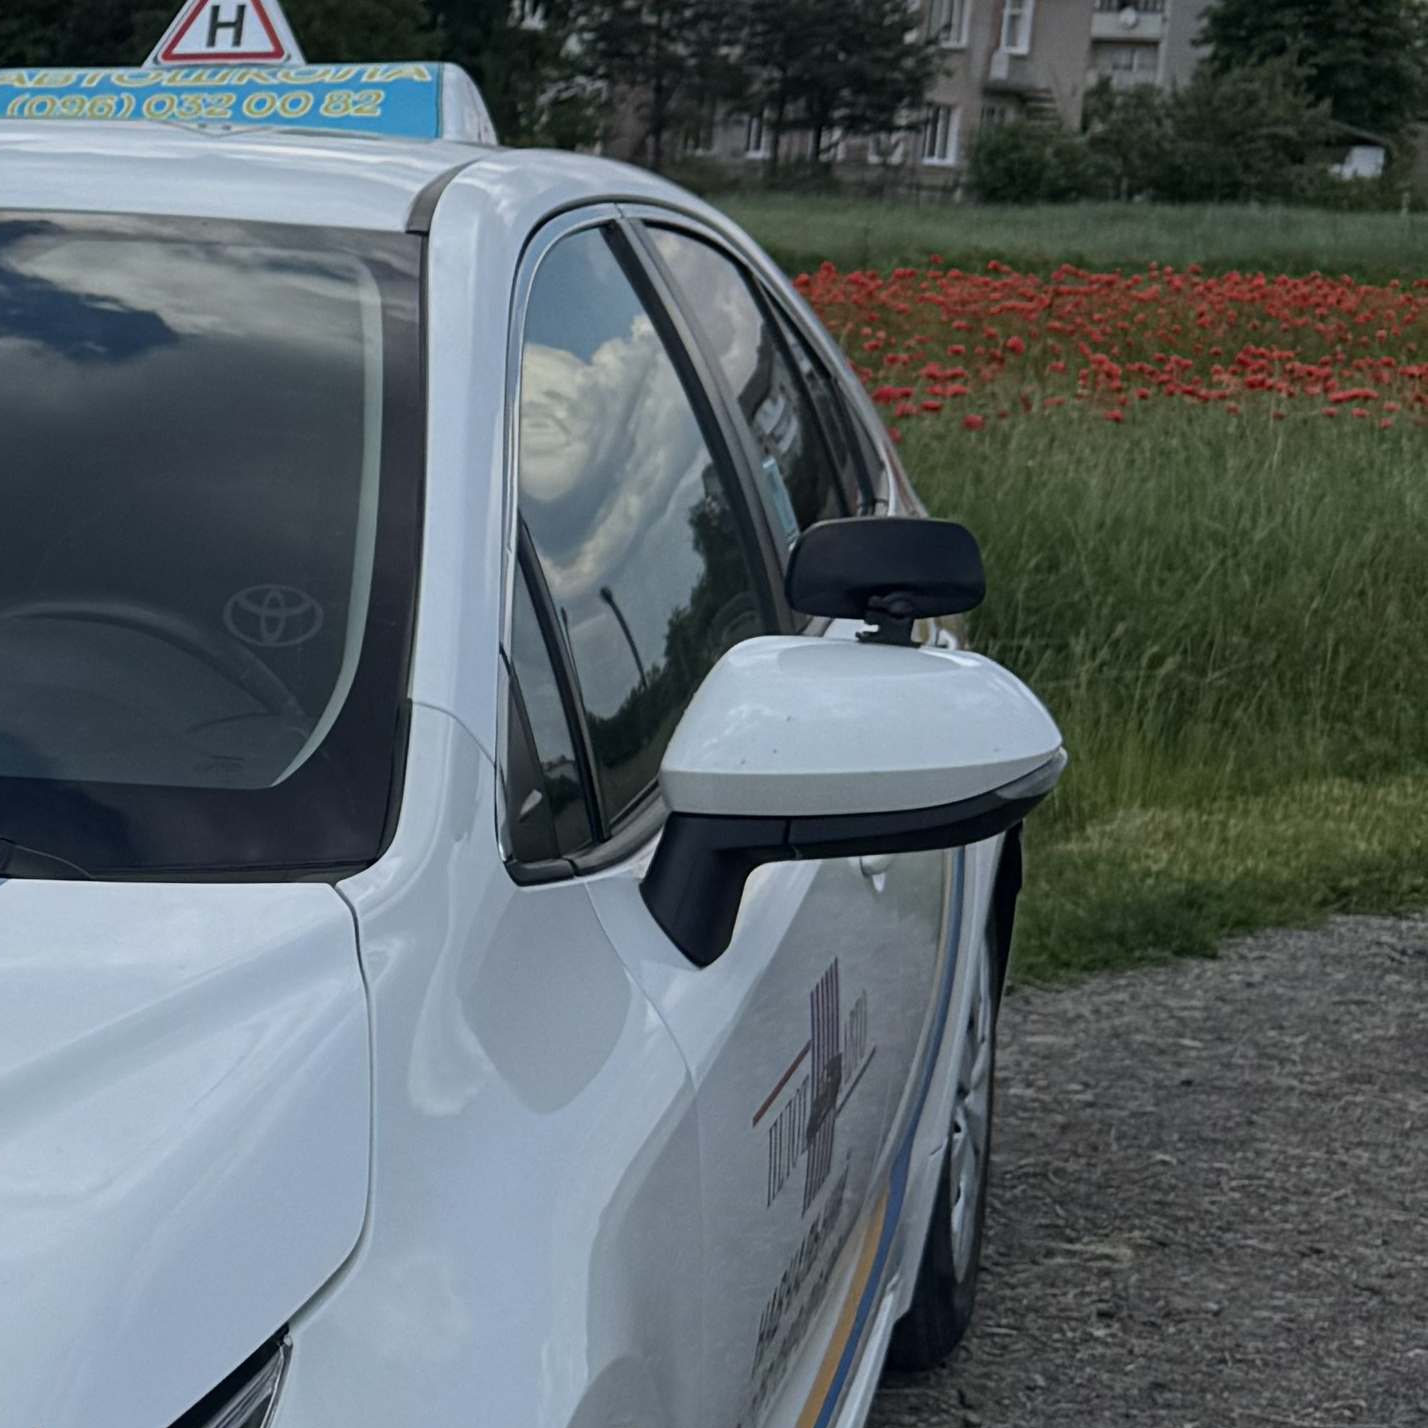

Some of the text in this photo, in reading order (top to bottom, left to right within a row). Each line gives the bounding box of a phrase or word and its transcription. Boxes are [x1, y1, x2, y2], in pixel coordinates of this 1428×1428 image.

[5, 90, 385, 119] (096) 032 00 82
